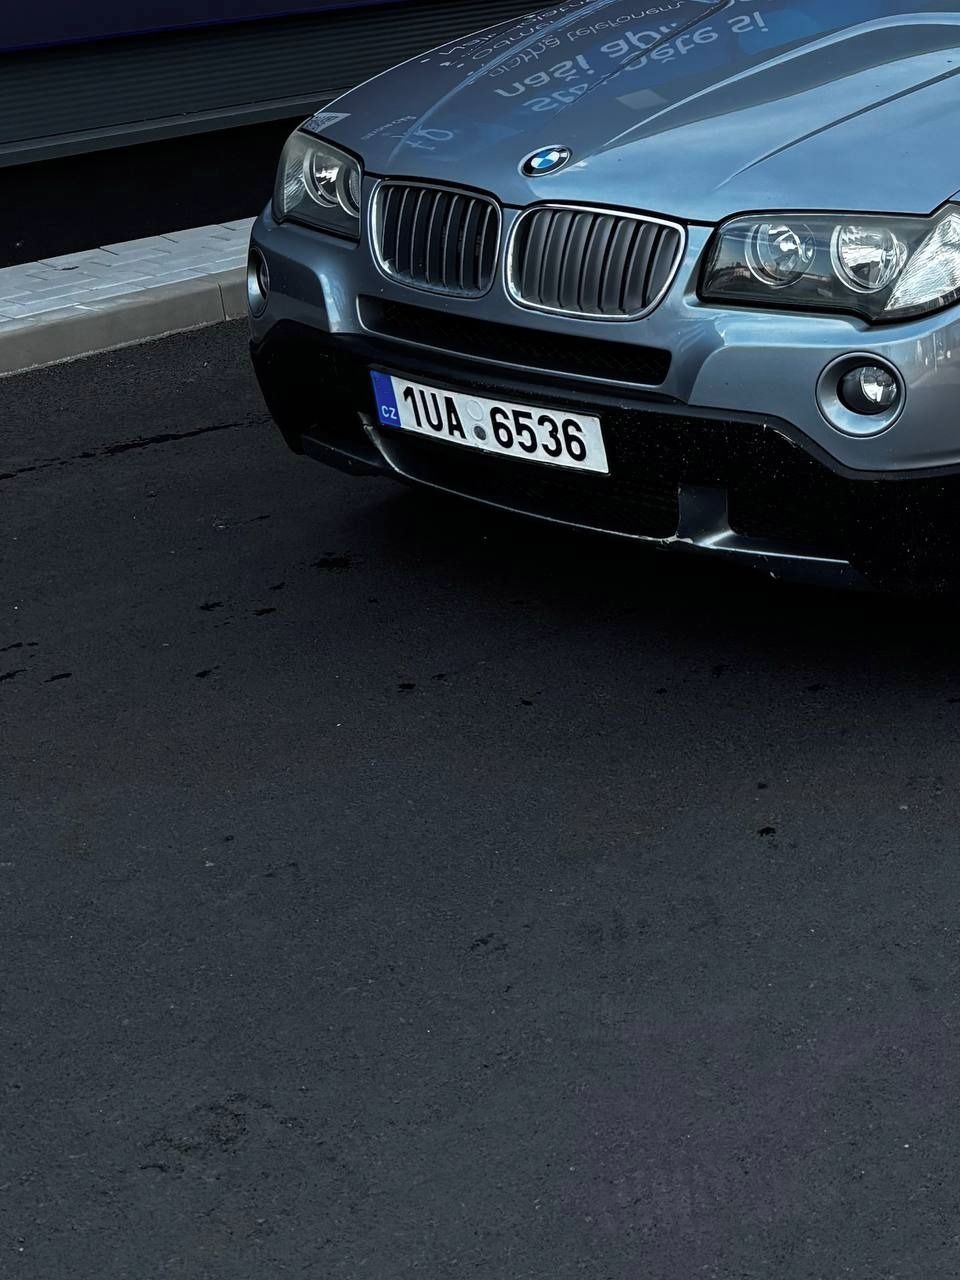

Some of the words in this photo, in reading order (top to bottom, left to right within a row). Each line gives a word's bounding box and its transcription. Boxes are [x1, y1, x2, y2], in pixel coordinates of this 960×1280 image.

[381, 405, 398, 420] CZ
[403, 384, 468, 441] 1UA
[489, 405, 588, 463] 6536
